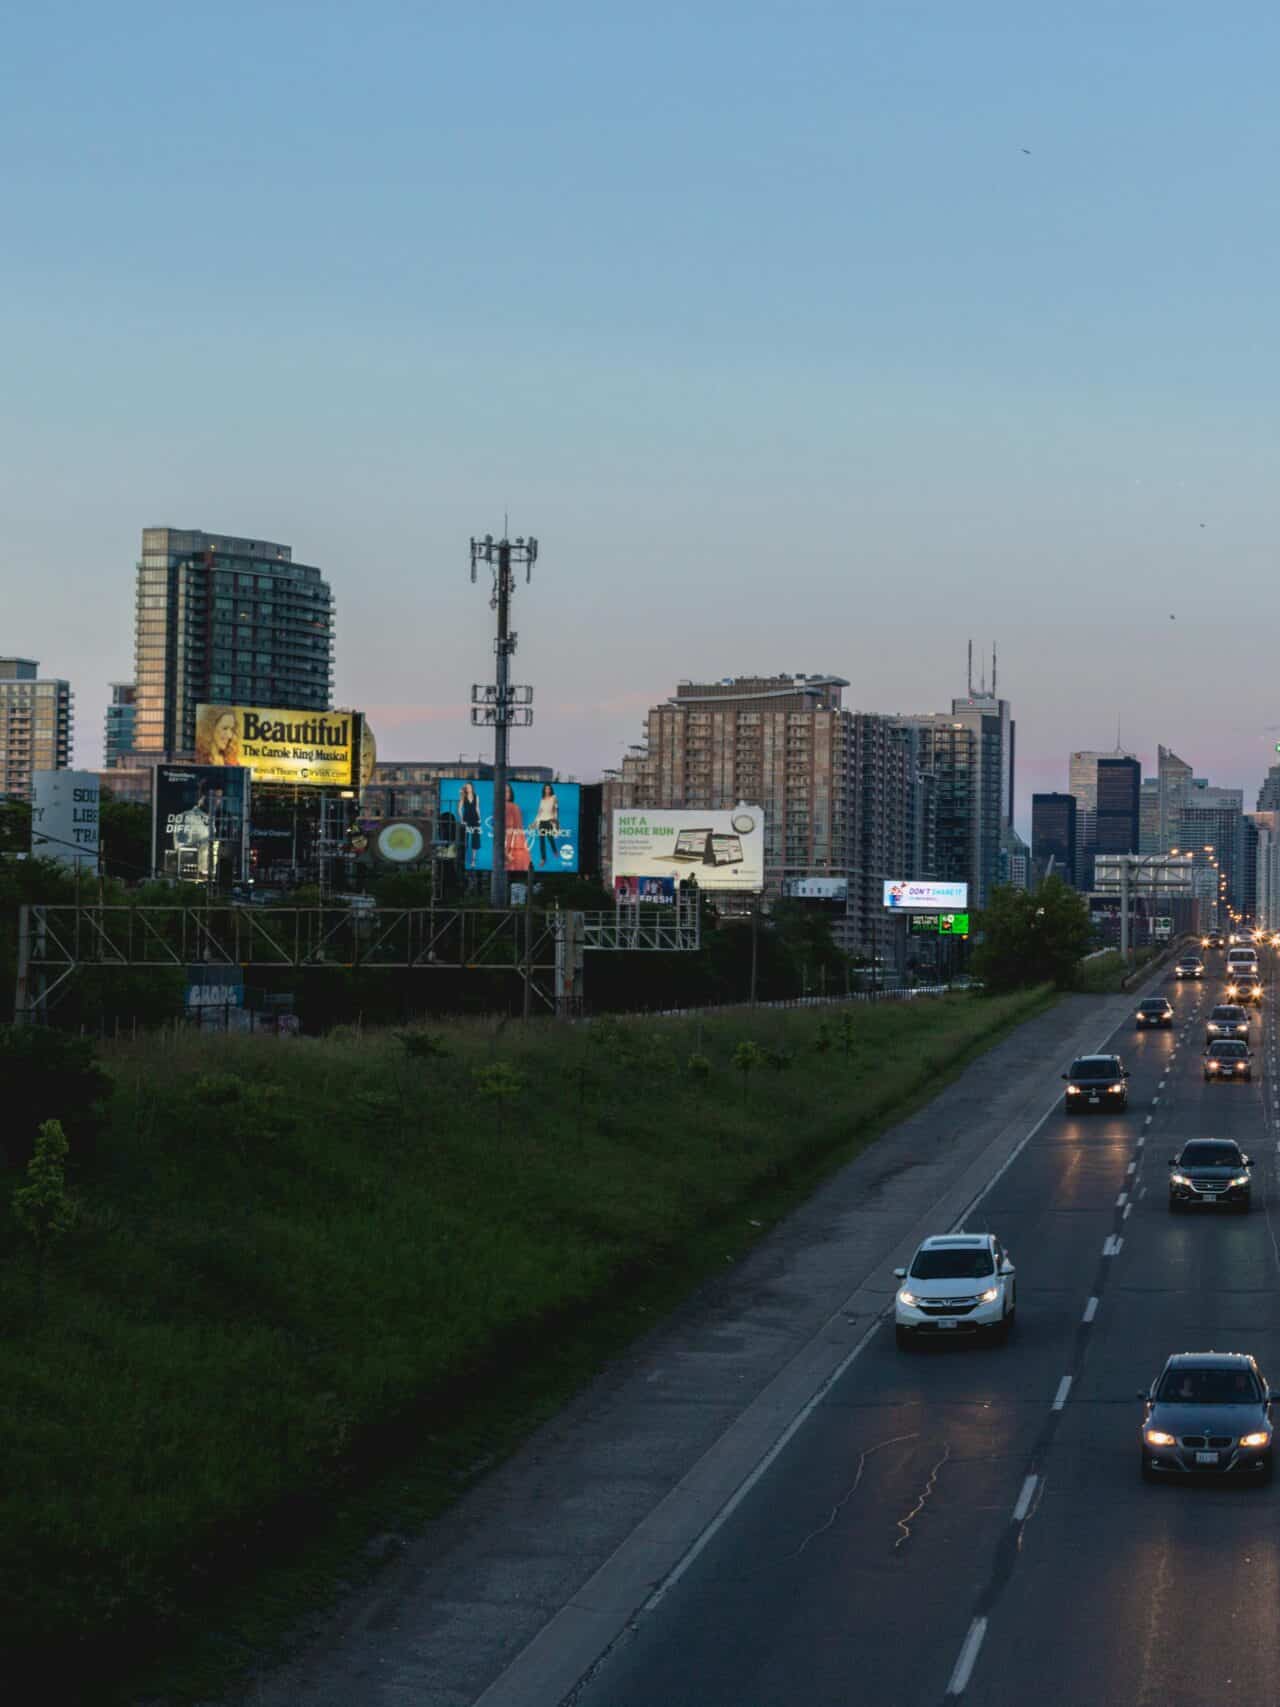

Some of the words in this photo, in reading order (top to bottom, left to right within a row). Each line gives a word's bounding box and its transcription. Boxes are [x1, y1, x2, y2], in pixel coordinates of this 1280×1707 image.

[243, 712, 348, 746] Beautiful
[243, 744, 260, 756] The
[262, 746, 291, 758] Carole
[293, 748, 314, 762] King
[315, 749, 348, 761] Musical
[619, 816, 636, 825] HIT
[640, 816, 647, 825] A
[619, 826, 650, 836] HOME
[652, 826, 674, 836] RUN
[909, 887, 930, 895] DON'T
